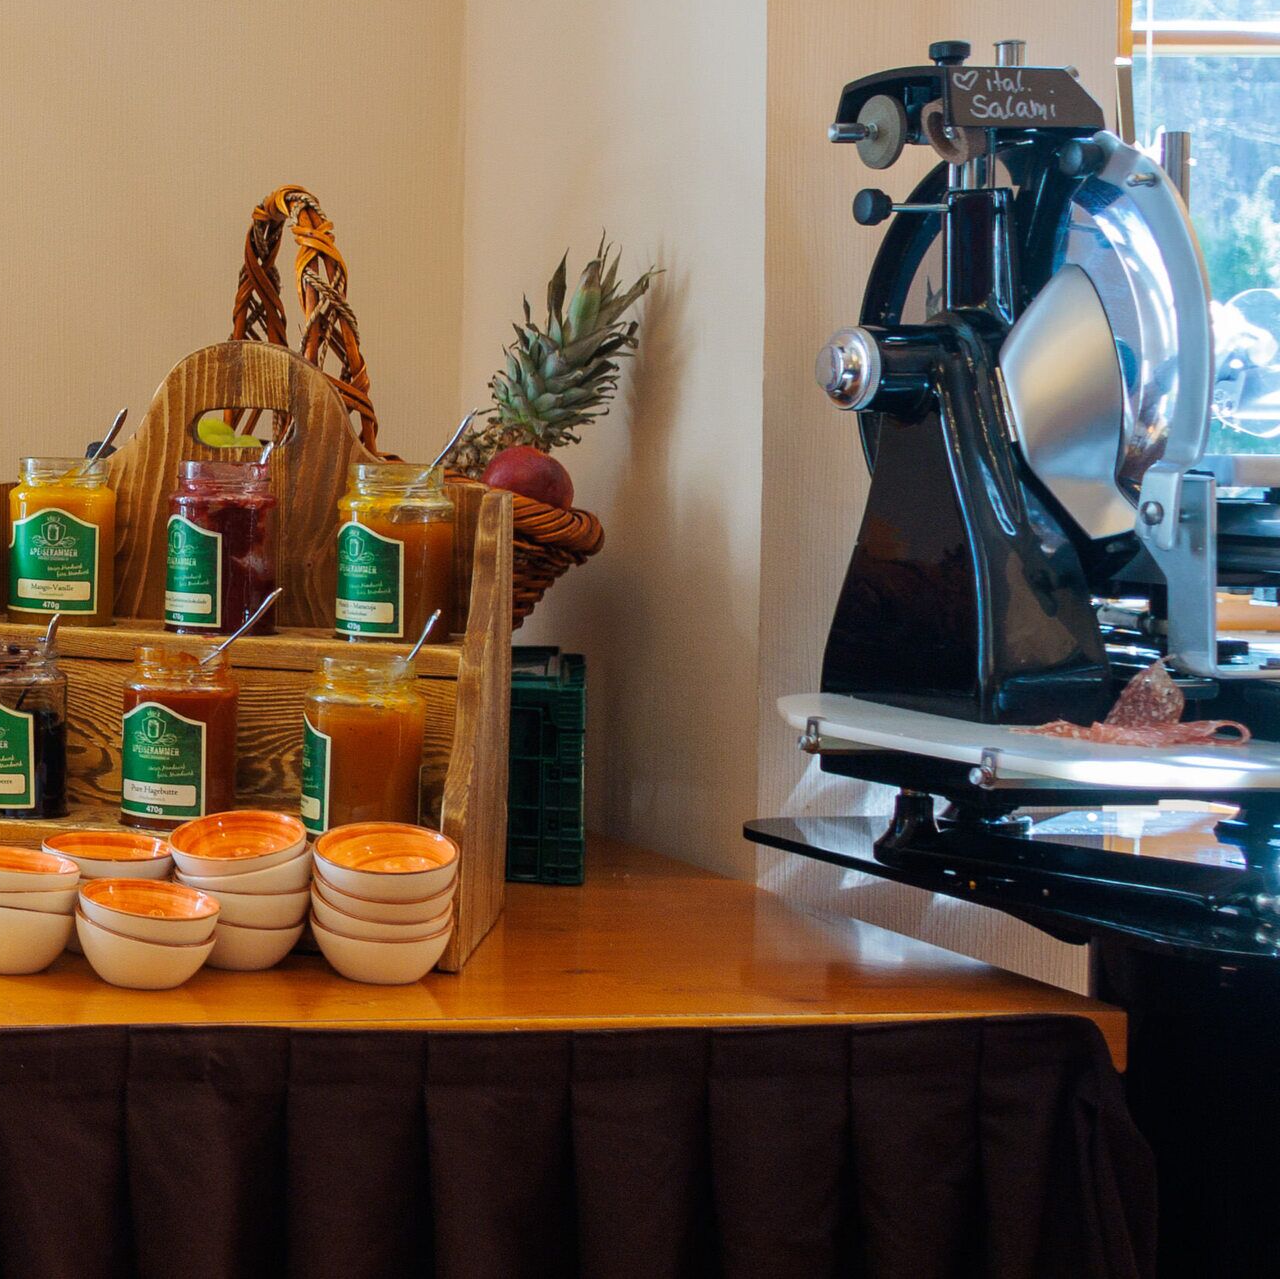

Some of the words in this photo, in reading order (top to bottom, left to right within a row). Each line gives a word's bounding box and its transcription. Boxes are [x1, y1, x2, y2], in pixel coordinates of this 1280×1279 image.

[986, 69, 1032, 94] ital.
[969, 90, 1057, 120] Salami
[42, 600, 61, 611] 470g
[143, 785, 179, 797] Hagebutte
[145, 804, 164, 815] 470g
